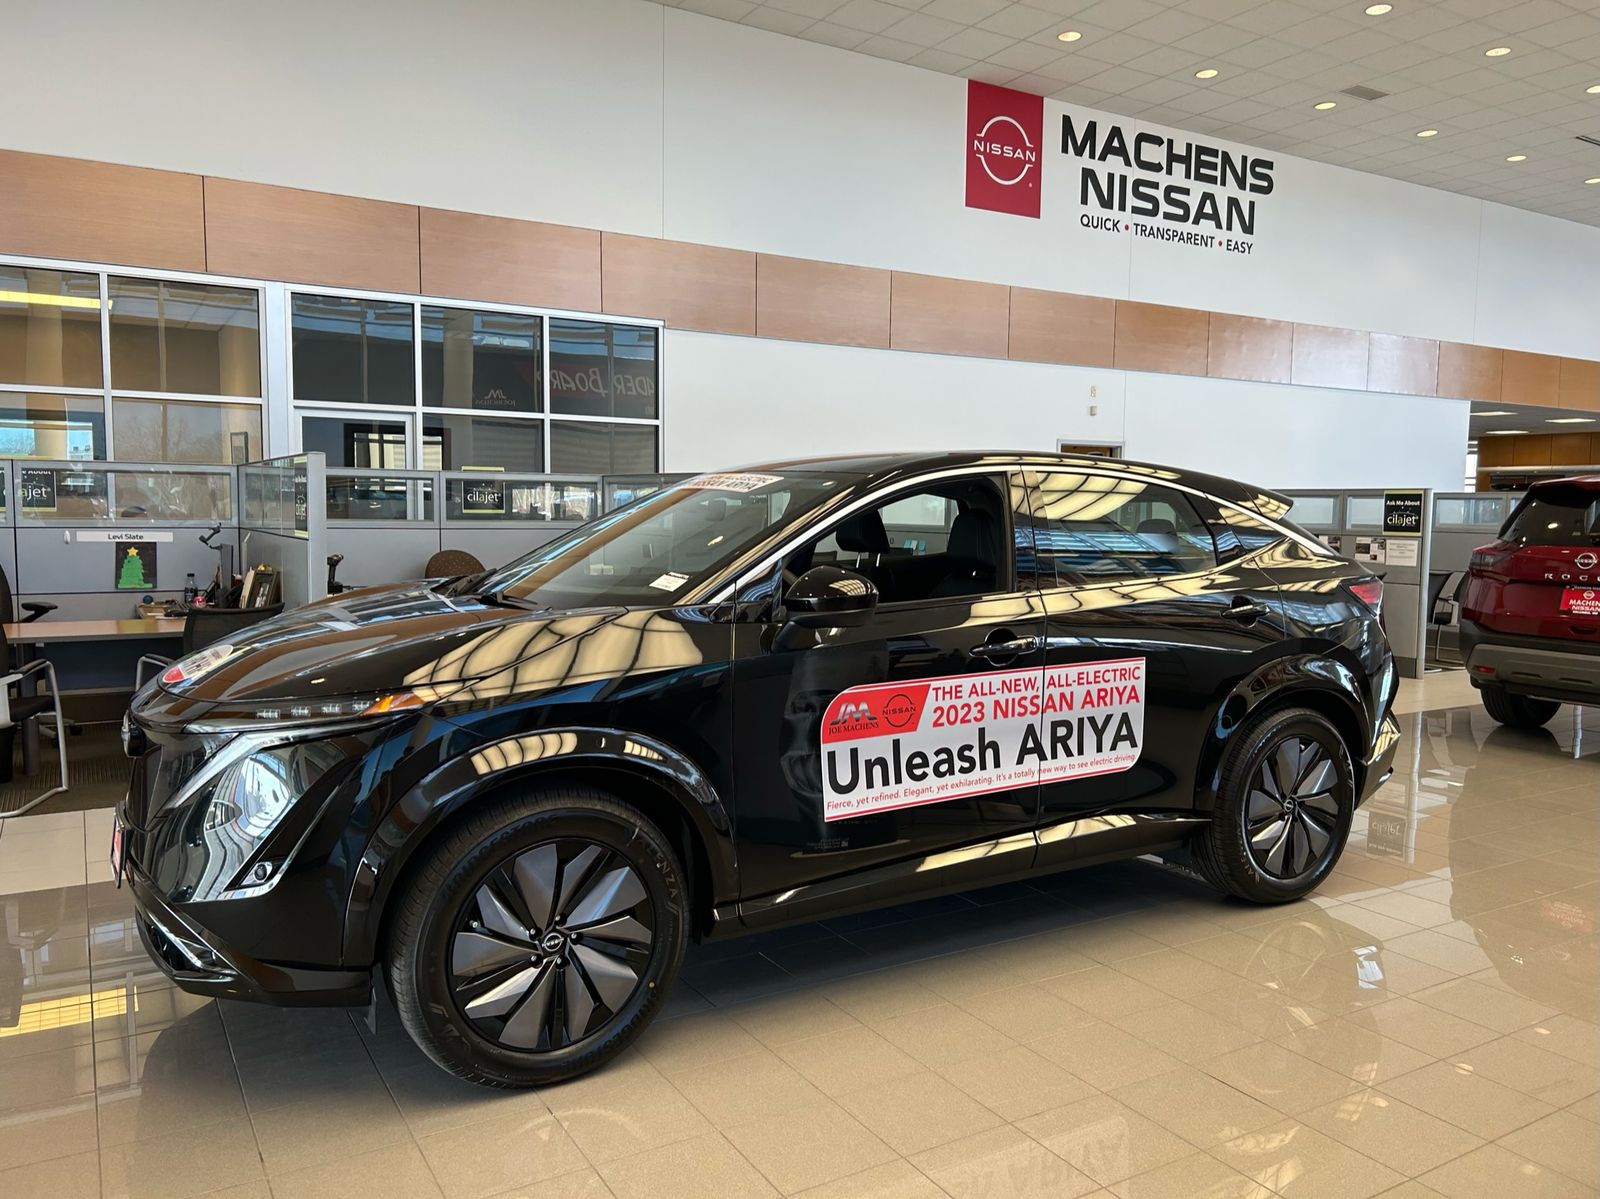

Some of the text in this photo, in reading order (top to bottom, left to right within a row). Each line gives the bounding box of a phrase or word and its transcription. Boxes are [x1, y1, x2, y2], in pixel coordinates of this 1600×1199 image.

[973, 139, 1036, 162] NISSAN
[1060, 113, 1274, 195] MACHENS
[1080, 166, 1256, 236] NISSAN
[1080, 213, 1254, 255] QUICK TRANSPARENT EASY
[466, 490, 499, 505] cilajet
[1386, 513, 1416, 527] cilajet
[932, 666, 1141, 702] THE ALL-NEW, ALL-ELECTRIC
[882, 706, 917, 716] NISSAN
[932, 684, 1140, 728] 2023 NISSAN ARIYA
[828, 721, 879, 735] JOE MACHENS
[827, 711, 1138, 795] Unleash ARIYA
[826, 799, 854, 810] Fierce,
[856, 796, 869, 808] yet
[871, 790, 901, 802] refined.
[903, 785, 934, 798] Elegant,
[936, 783, 949, 793] yet
[950, 776, 994, 790] exhilarating.
[996, 773, 1007, 782] It's
[1014, 768, 1036, 779] totally
[1053, 764, 1067, 773] way
[1068, 762, 1076, 770] to
[1089, 757, 1113, 767] electric
